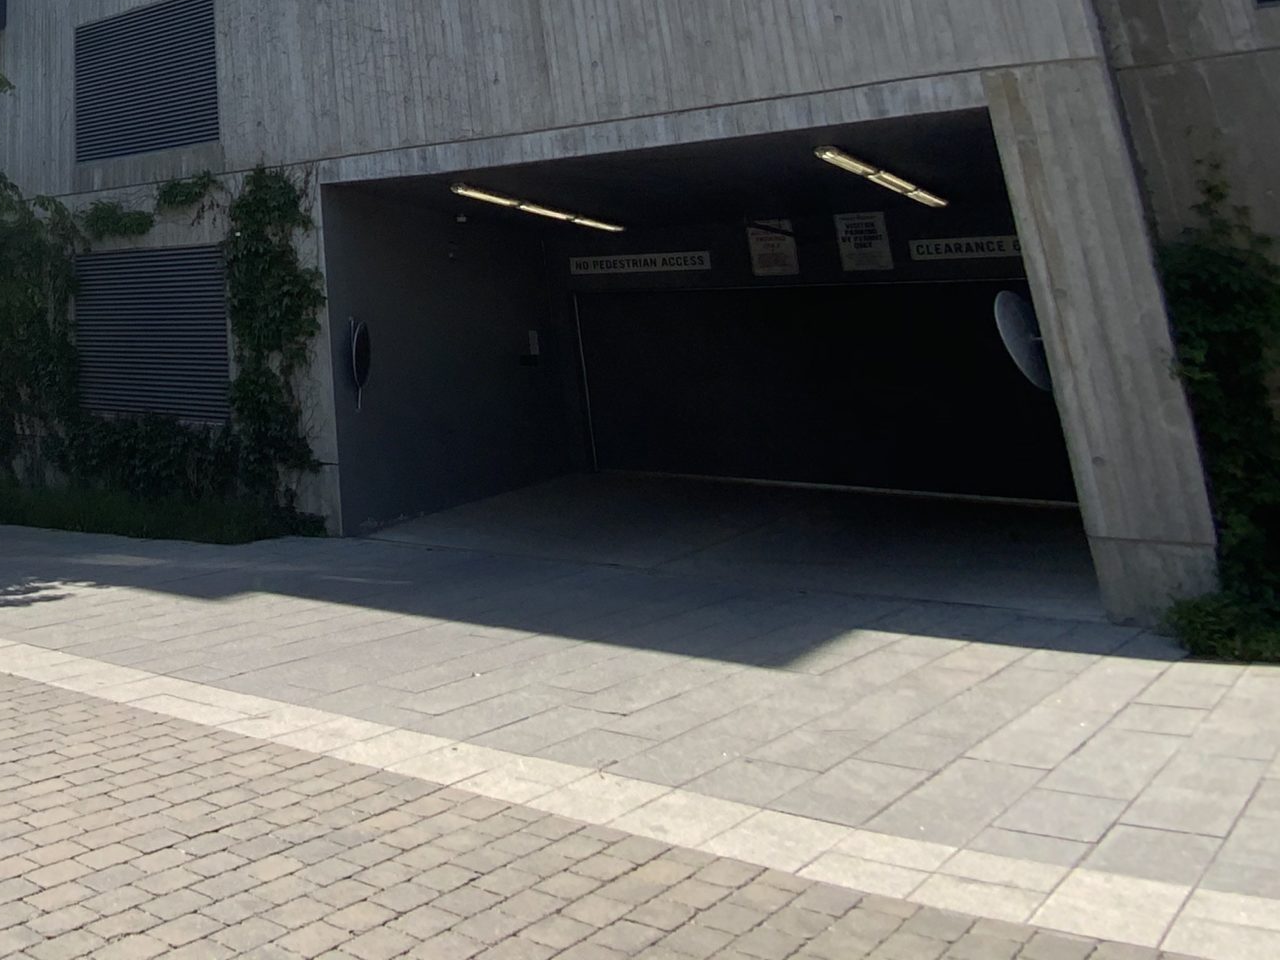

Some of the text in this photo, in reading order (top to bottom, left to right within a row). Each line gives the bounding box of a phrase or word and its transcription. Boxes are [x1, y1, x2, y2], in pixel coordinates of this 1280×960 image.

[915, 239, 1005, 256] CLEARANCE
[575, 255, 705, 271] NO PEDESTRIAN ACCESS
